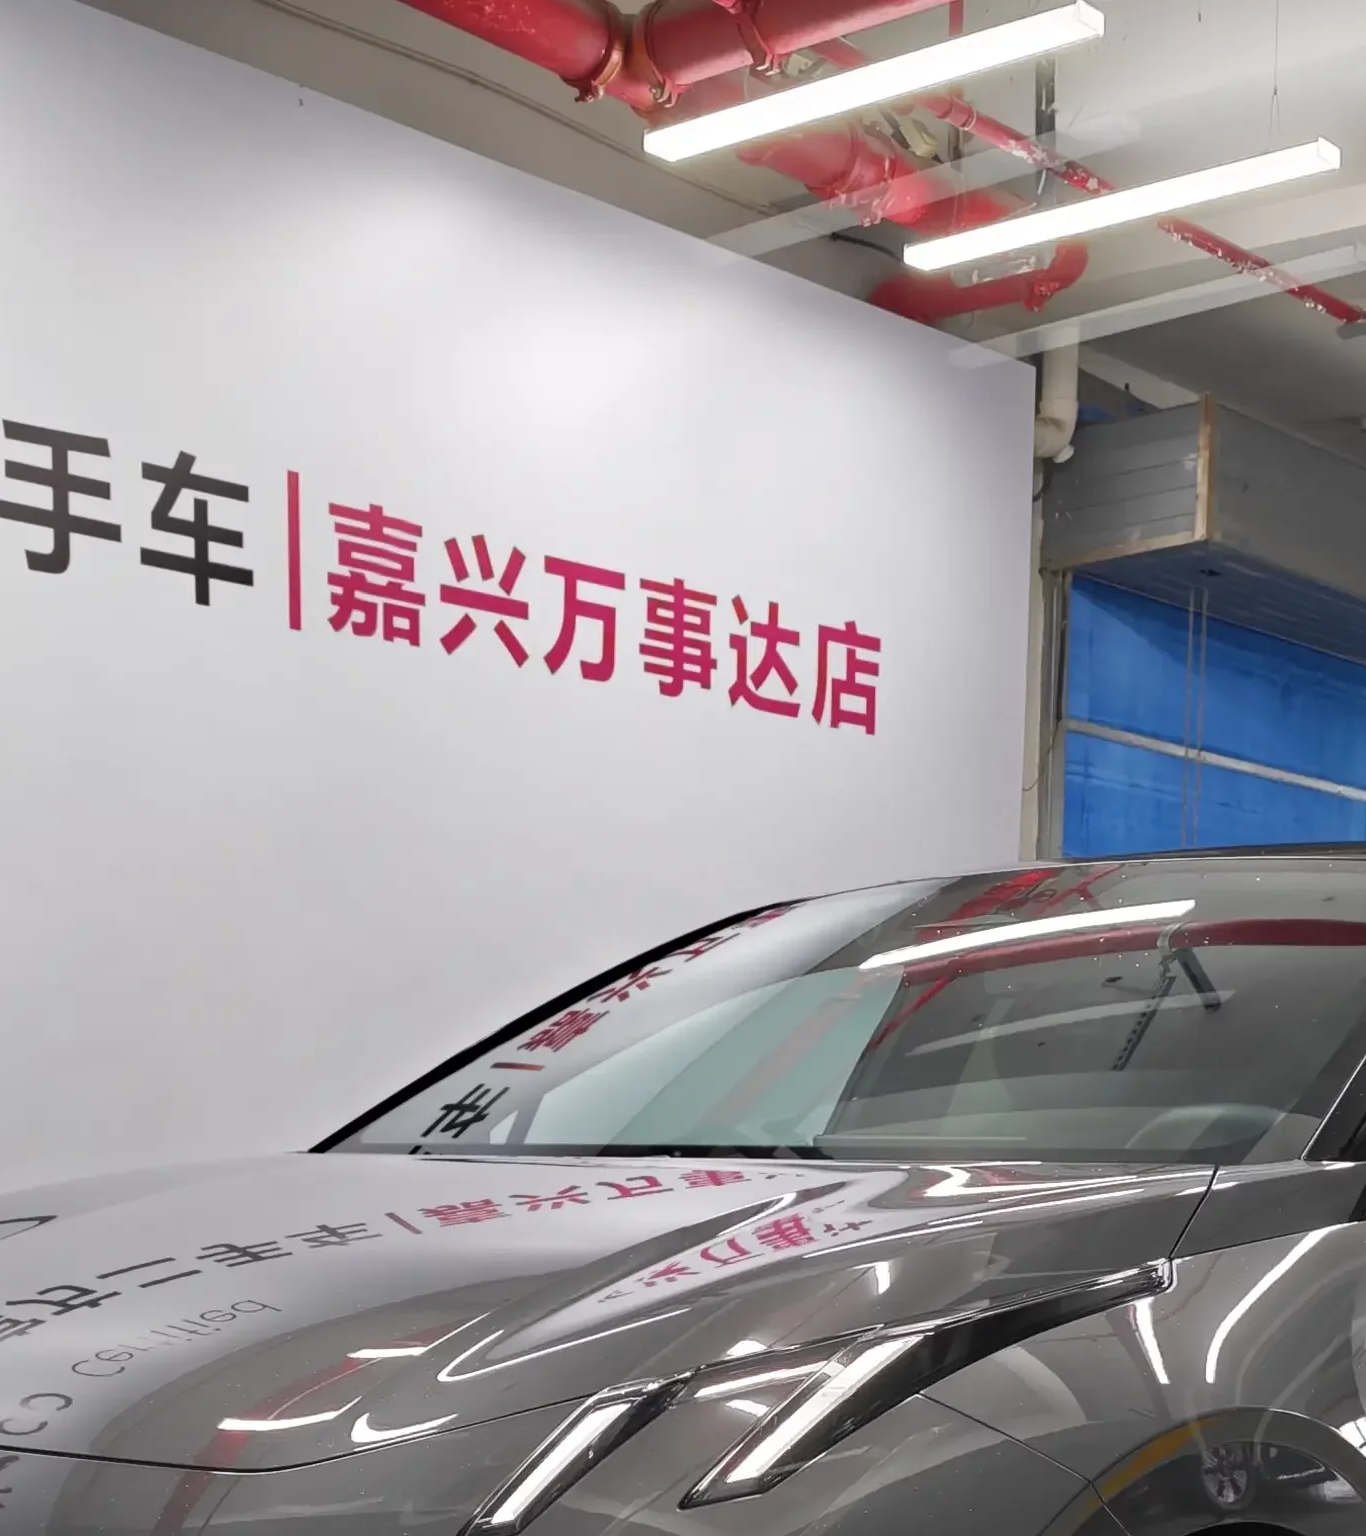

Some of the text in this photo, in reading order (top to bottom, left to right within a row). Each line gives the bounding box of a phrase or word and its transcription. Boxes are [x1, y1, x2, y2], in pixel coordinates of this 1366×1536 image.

[327, 501, 881, 735] 嘉兴万事达店
